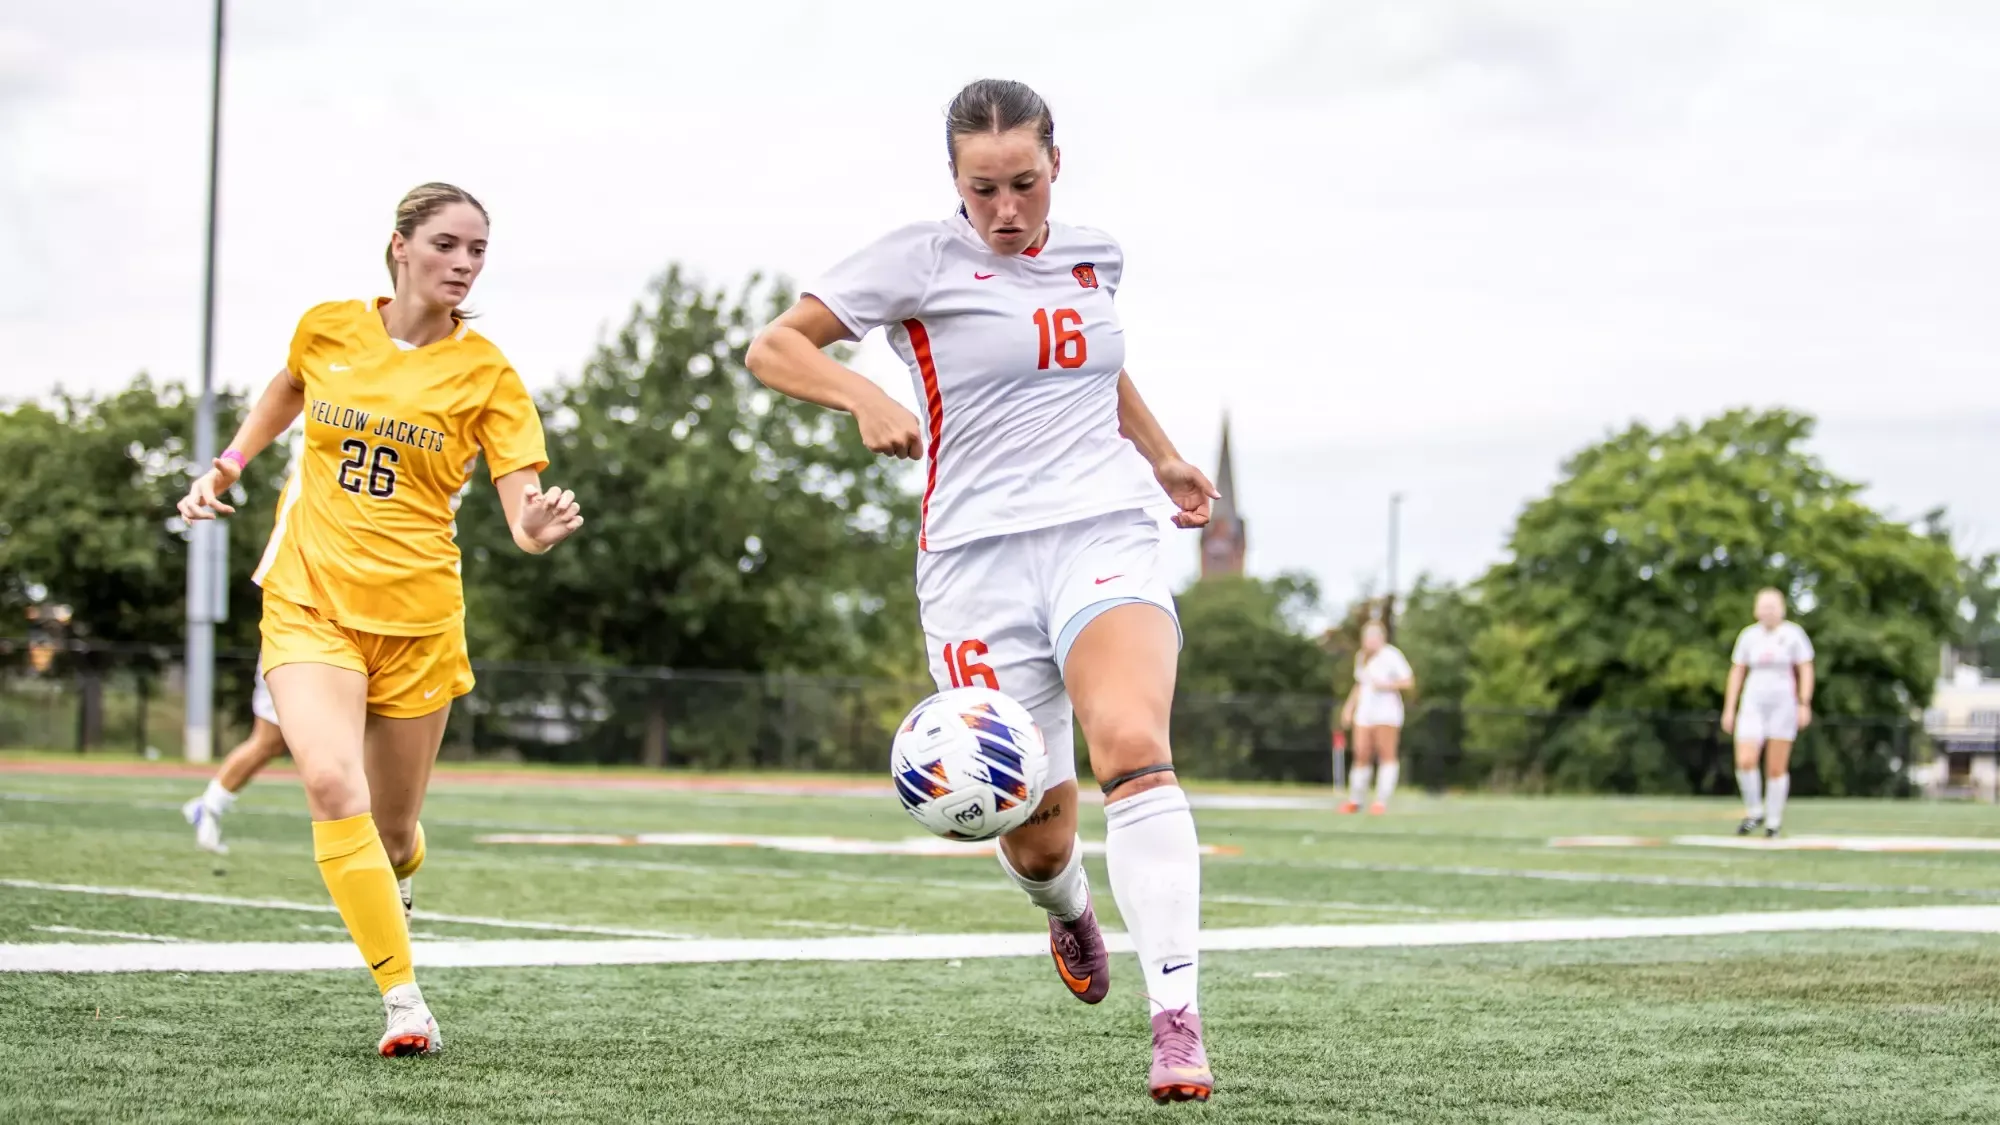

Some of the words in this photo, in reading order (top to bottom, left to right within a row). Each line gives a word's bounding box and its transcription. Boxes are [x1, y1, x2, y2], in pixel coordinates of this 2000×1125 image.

[1032, 308, 1087, 370] 16
[311, 400, 370, 432] YELLOW
[374, 417, 445, 452] JACKETS
[338, 438, 399, 498] 26
[943, 638, 1000, 691] 16
